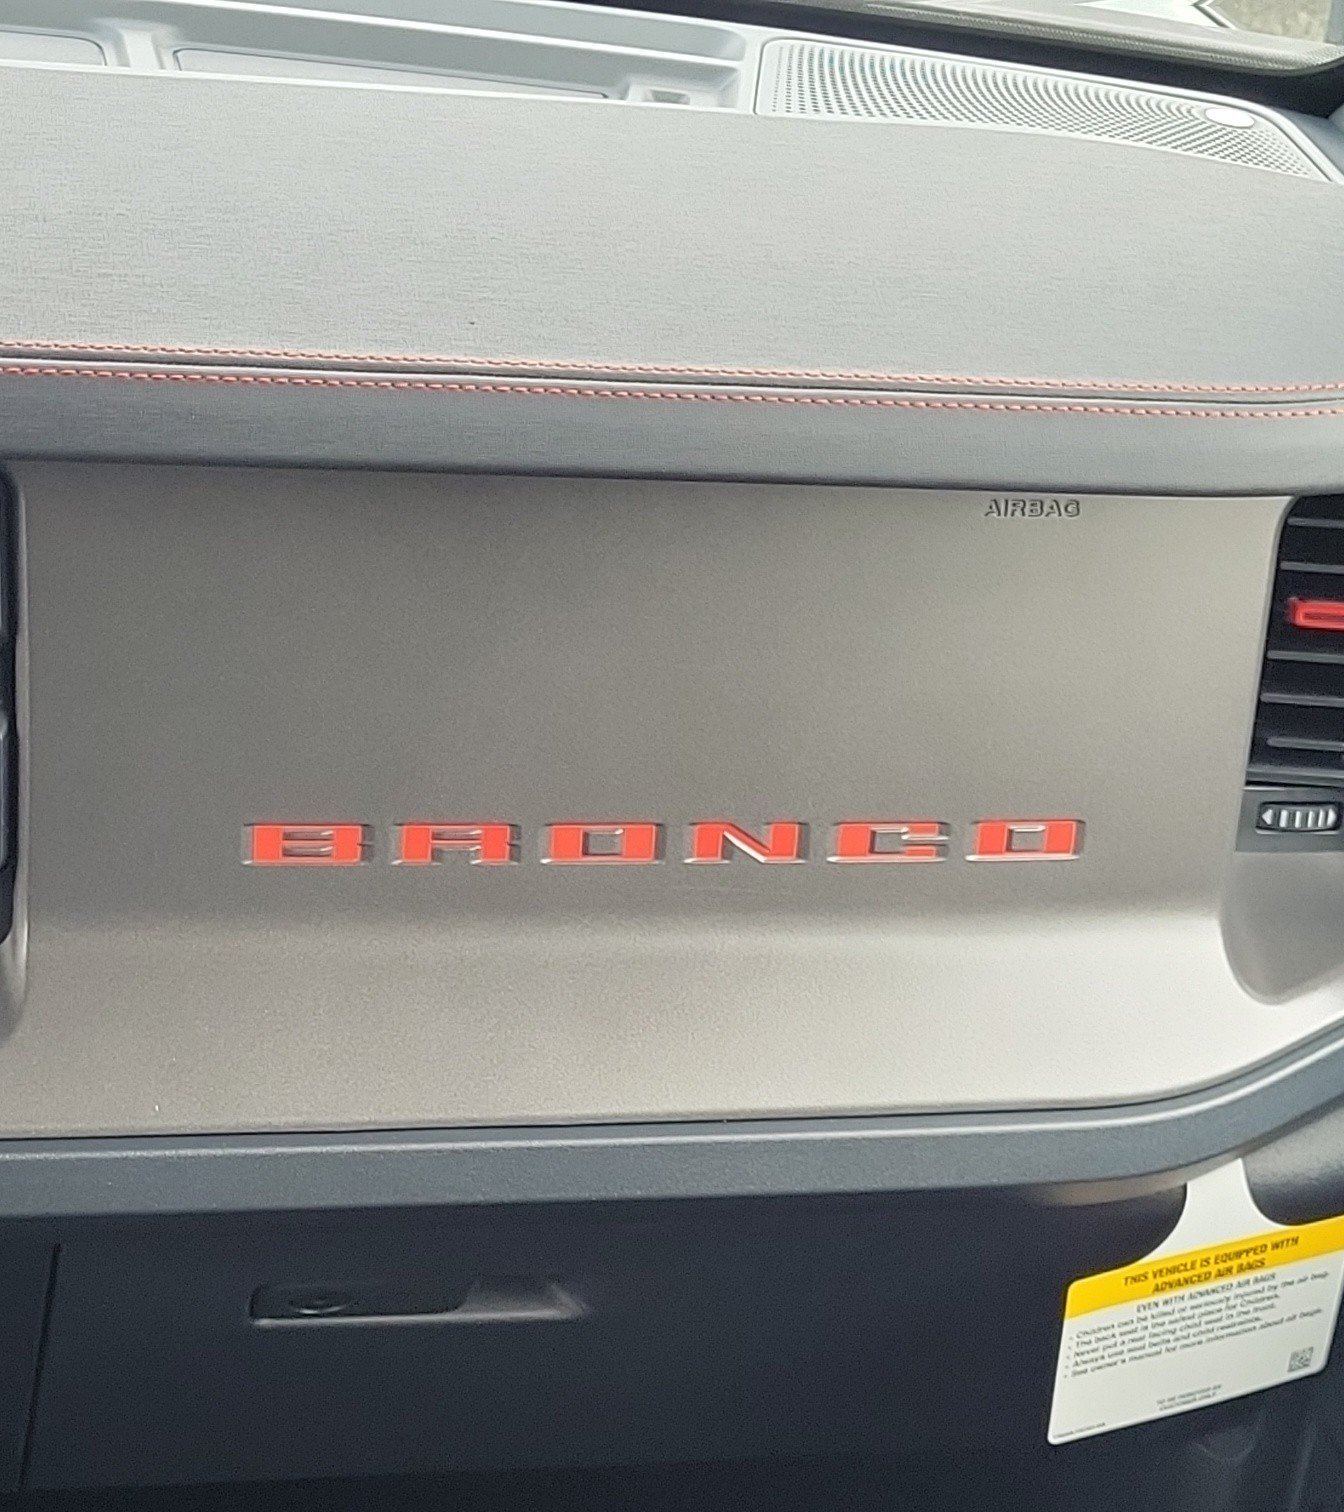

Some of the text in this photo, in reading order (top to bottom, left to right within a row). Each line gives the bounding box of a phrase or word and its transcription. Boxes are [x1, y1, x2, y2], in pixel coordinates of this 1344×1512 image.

[984, 498, 1081, 518] AIRBAG
[242, 819, 1086, 869] BRONCO
[1124, 1236, 1300, 1287] THIS VEHICLE IS EQUIPPED WITH
[1151, 1257, 1266, 1294] ADVANCED AIR BAGS
